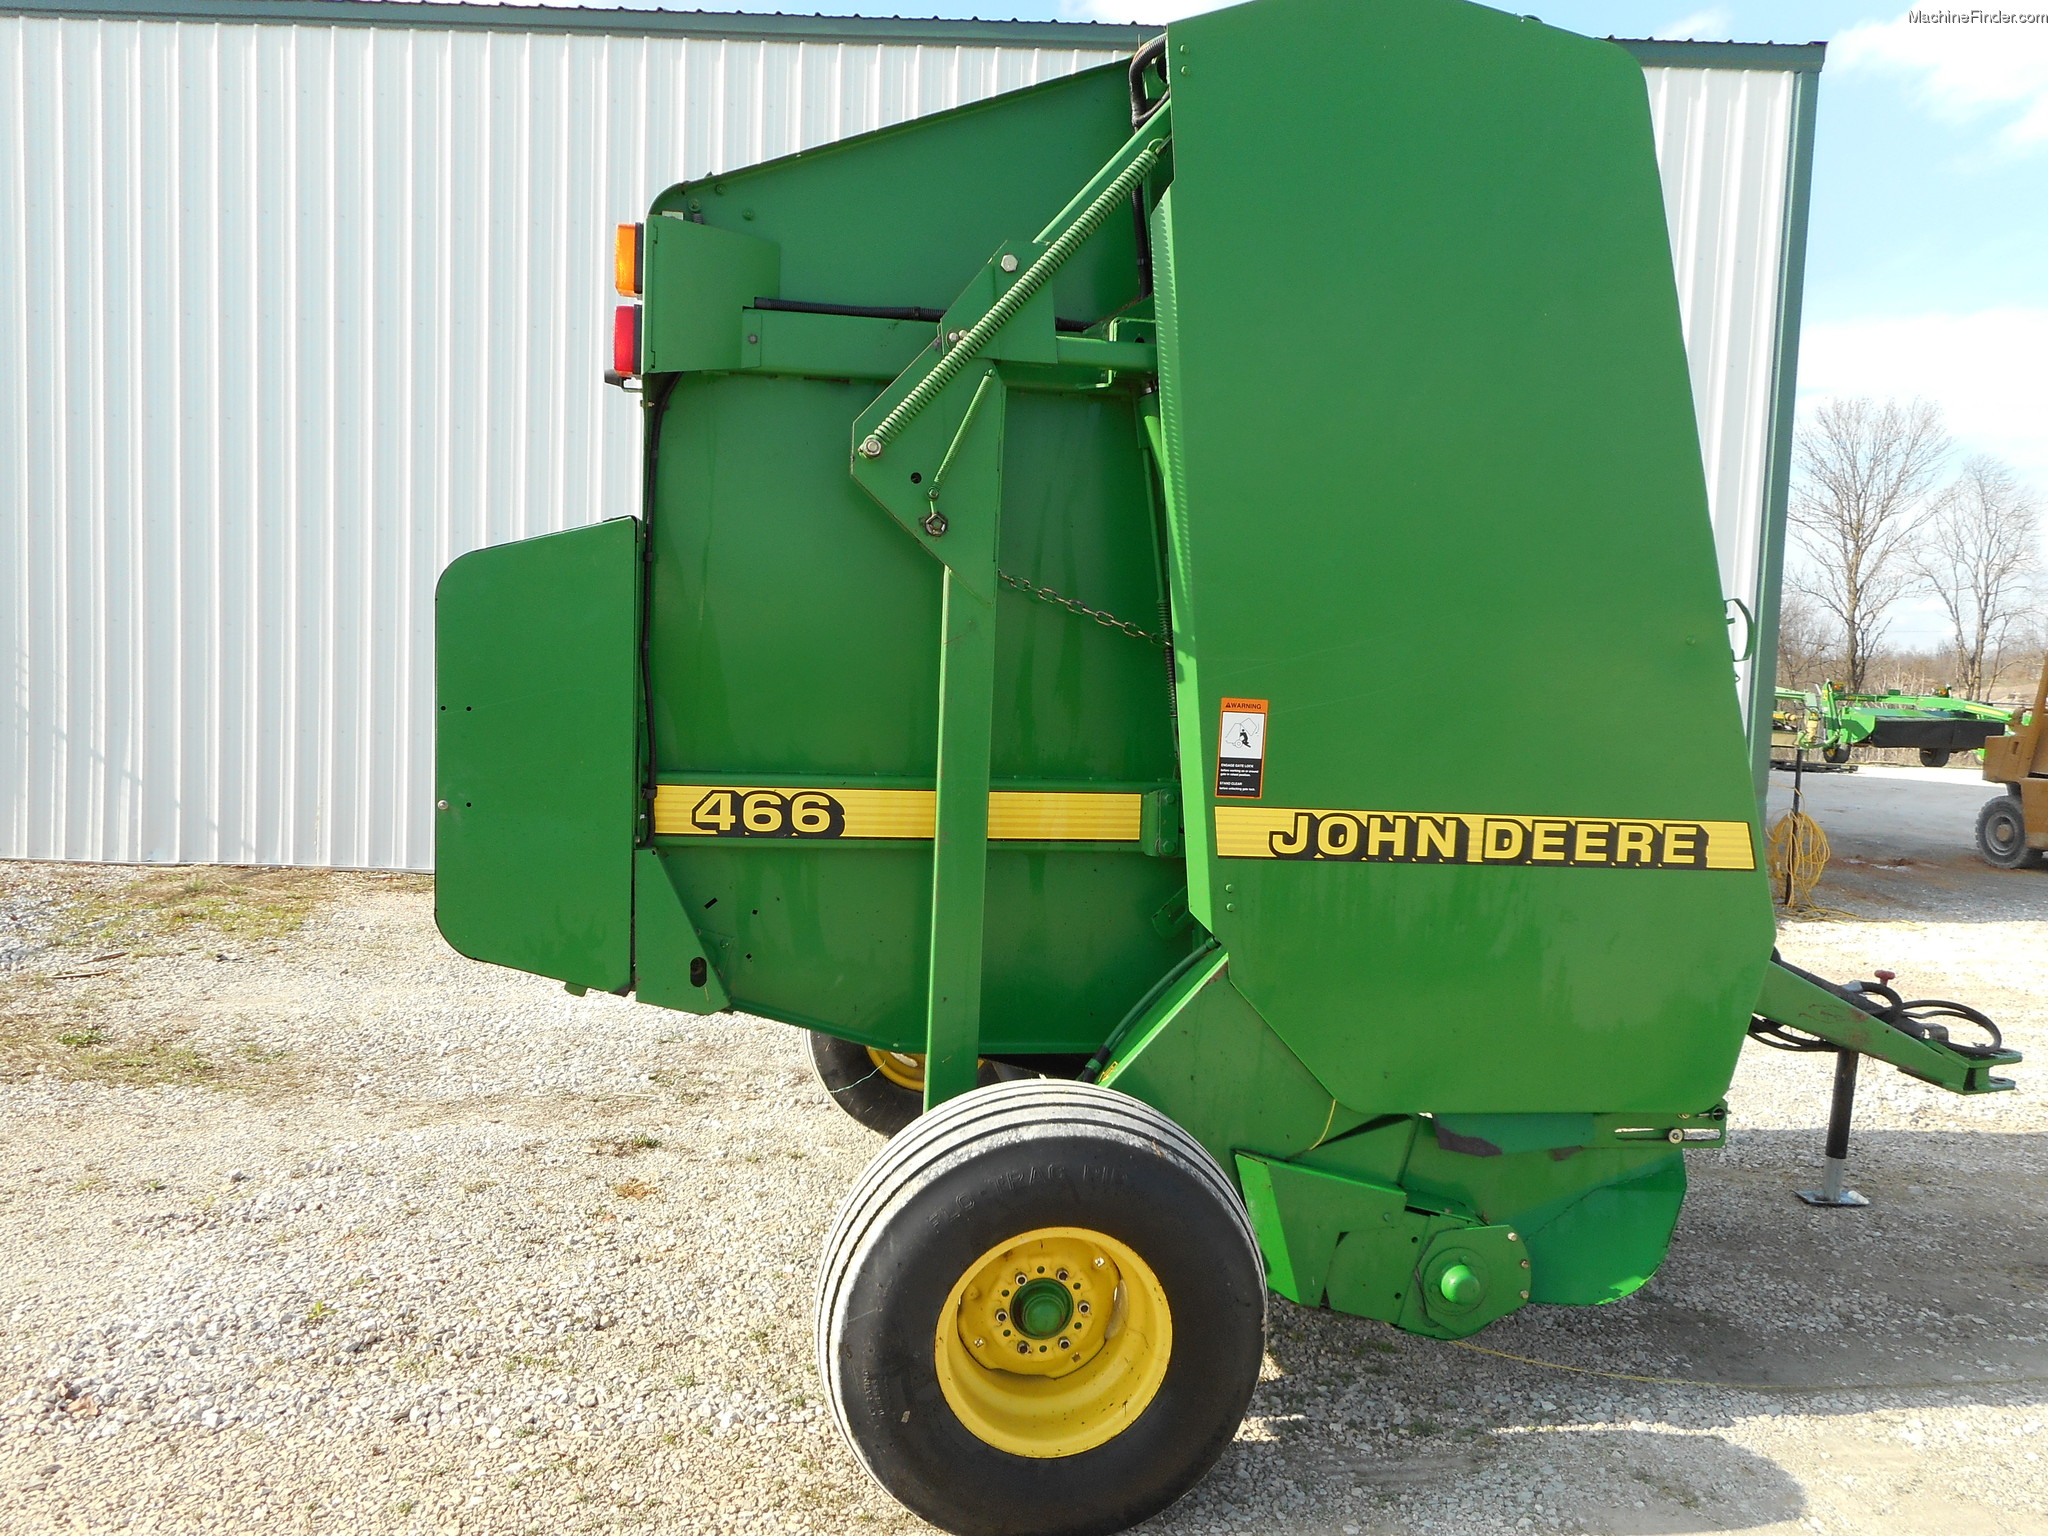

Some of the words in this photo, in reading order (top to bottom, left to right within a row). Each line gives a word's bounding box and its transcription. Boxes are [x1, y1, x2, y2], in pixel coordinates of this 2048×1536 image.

[1231, 702, 1262, 710] WARNING
[693, 790, 838, 834] 466
[1271, 813, 1463, 861] JOHN
[1483, 818, 1704, 867] DEERE
